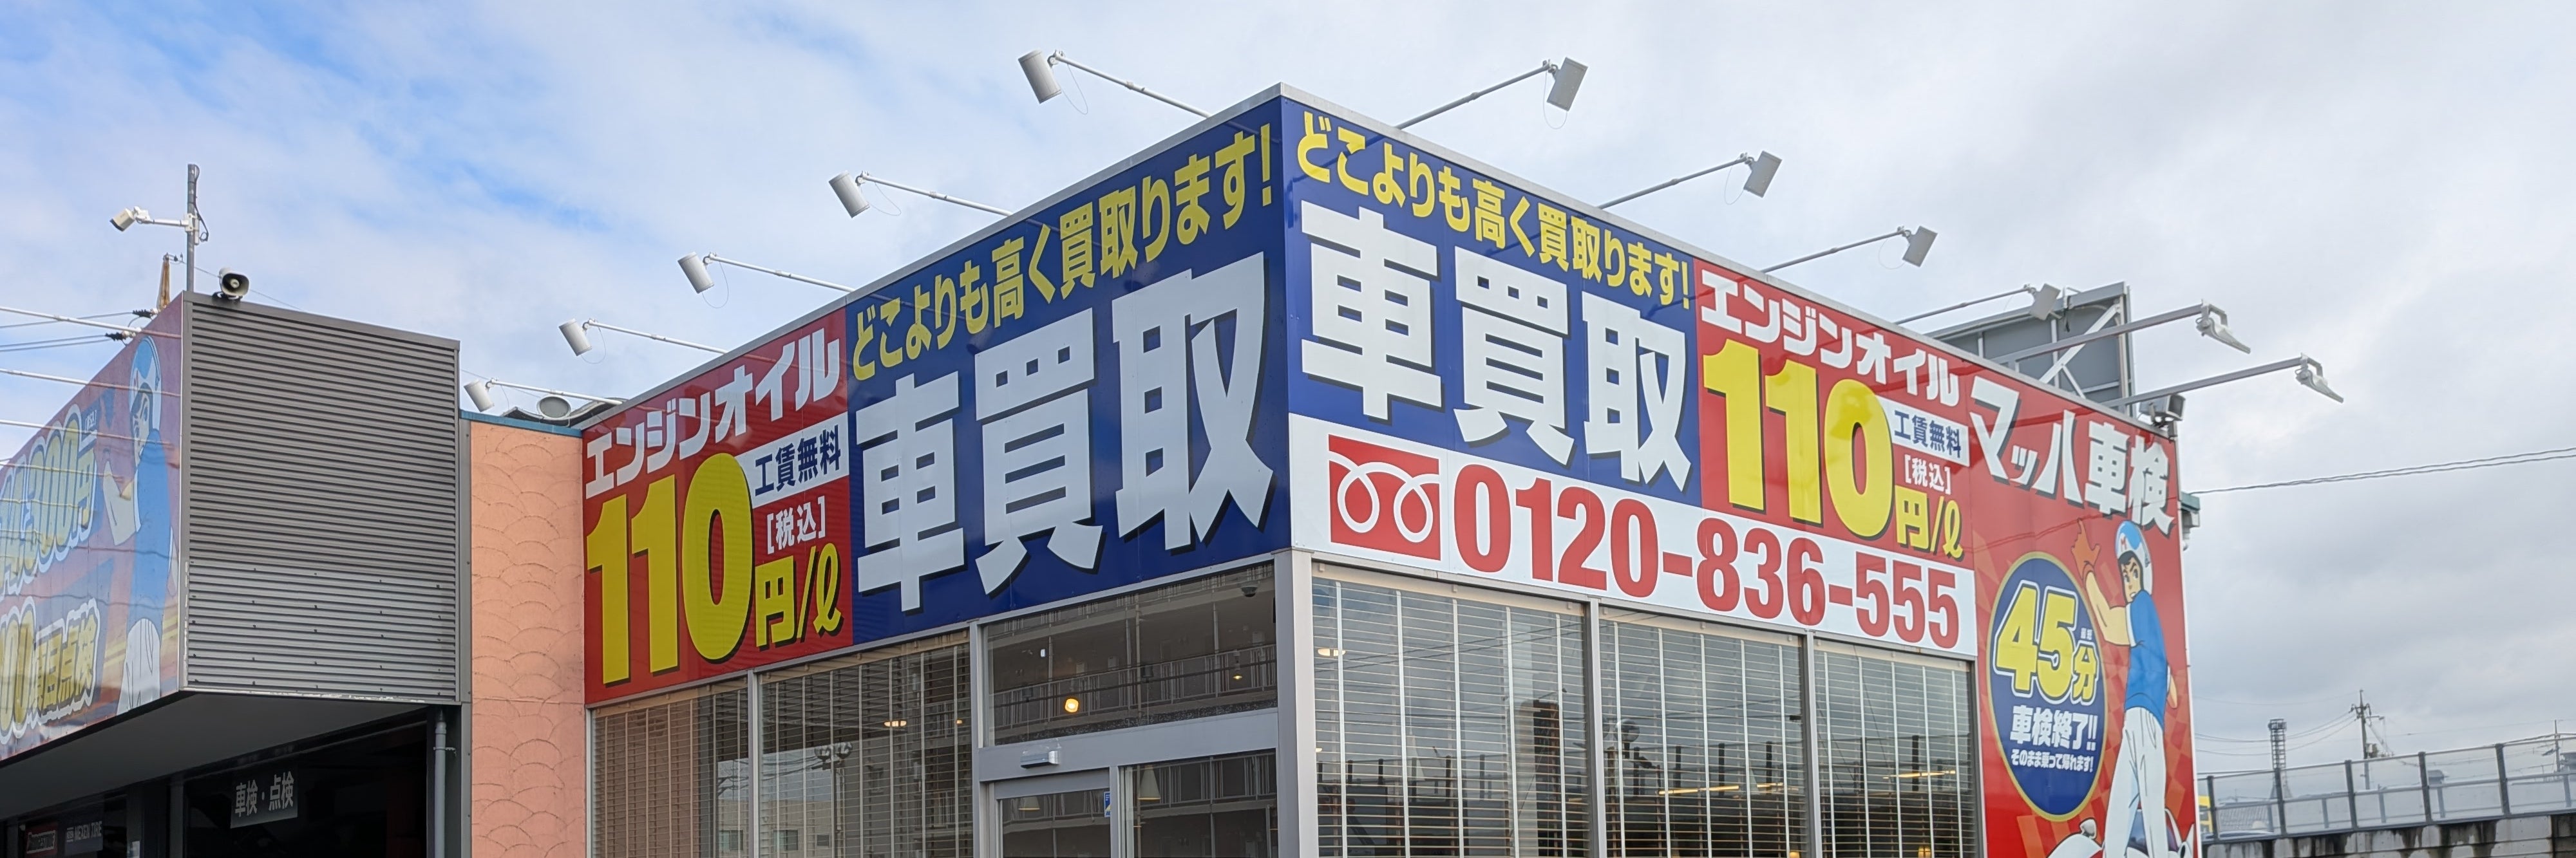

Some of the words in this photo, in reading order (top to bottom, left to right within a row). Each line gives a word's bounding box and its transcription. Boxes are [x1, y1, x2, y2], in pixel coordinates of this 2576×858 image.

[853, 124, 1272, 380] どこよりも高く買取ります!
[1297, 111, 1690, 310] どこよりも高く買取ります!
[585, 328, 839, 499] エンジンオイル
[1302, 200, 1692, 492] 車買取
[1701, 269, 1960, 407] エンジンオイル
[754, 424, 841, 497] 工賃無料
[856, 252, 1274, 612] 車買取
[1894, 410, 1962, 458] 工賃無料
[1969, 375, 2175, 536] マッハ車検
[1454, 463, 1960, 649] 0120-836-555
